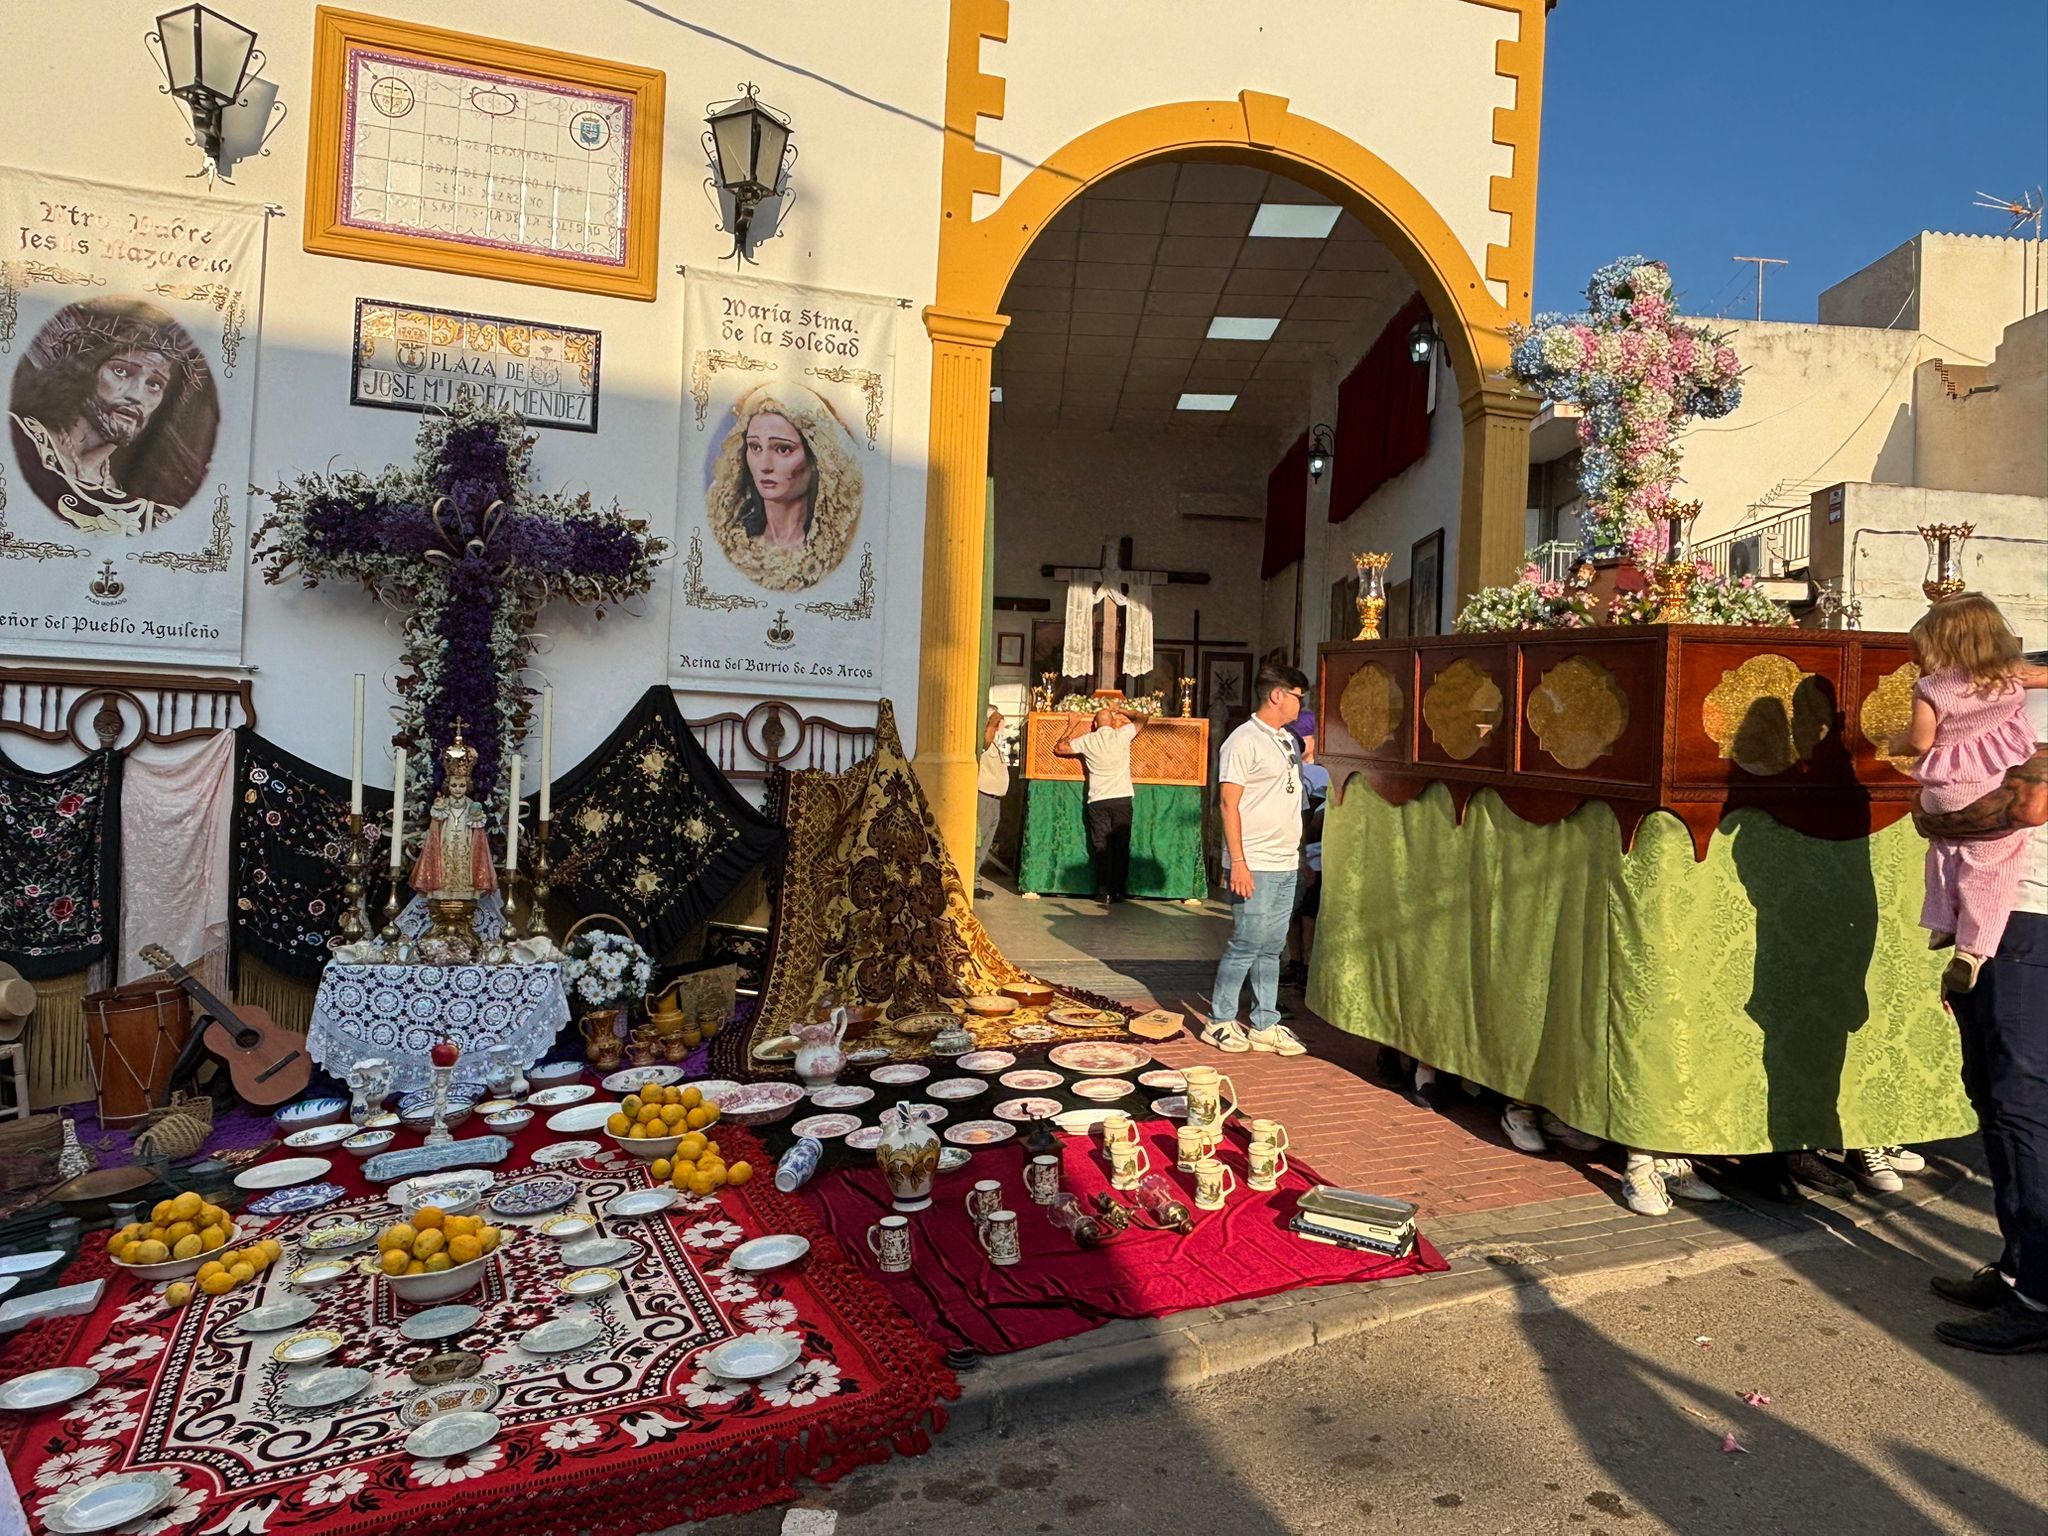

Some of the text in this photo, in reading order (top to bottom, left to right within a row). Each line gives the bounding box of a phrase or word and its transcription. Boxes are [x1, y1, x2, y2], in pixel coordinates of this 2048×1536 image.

[798, 308, 859, 334] Stma.
[722, 320, 860, 358] de la Soledad
[430, 351, 526, 382] PLAZA DE
[362, 371, 417, 401] JOSE
[513, 387, 587, 422] MENDEZ
[45, 615, 68, 630] del
[72, 616, 136, 634] Pueblo
[141, 620, 220, 640] Aguileño
[679, 654, 873, 678] Reina del Barrio de Los Arcos
